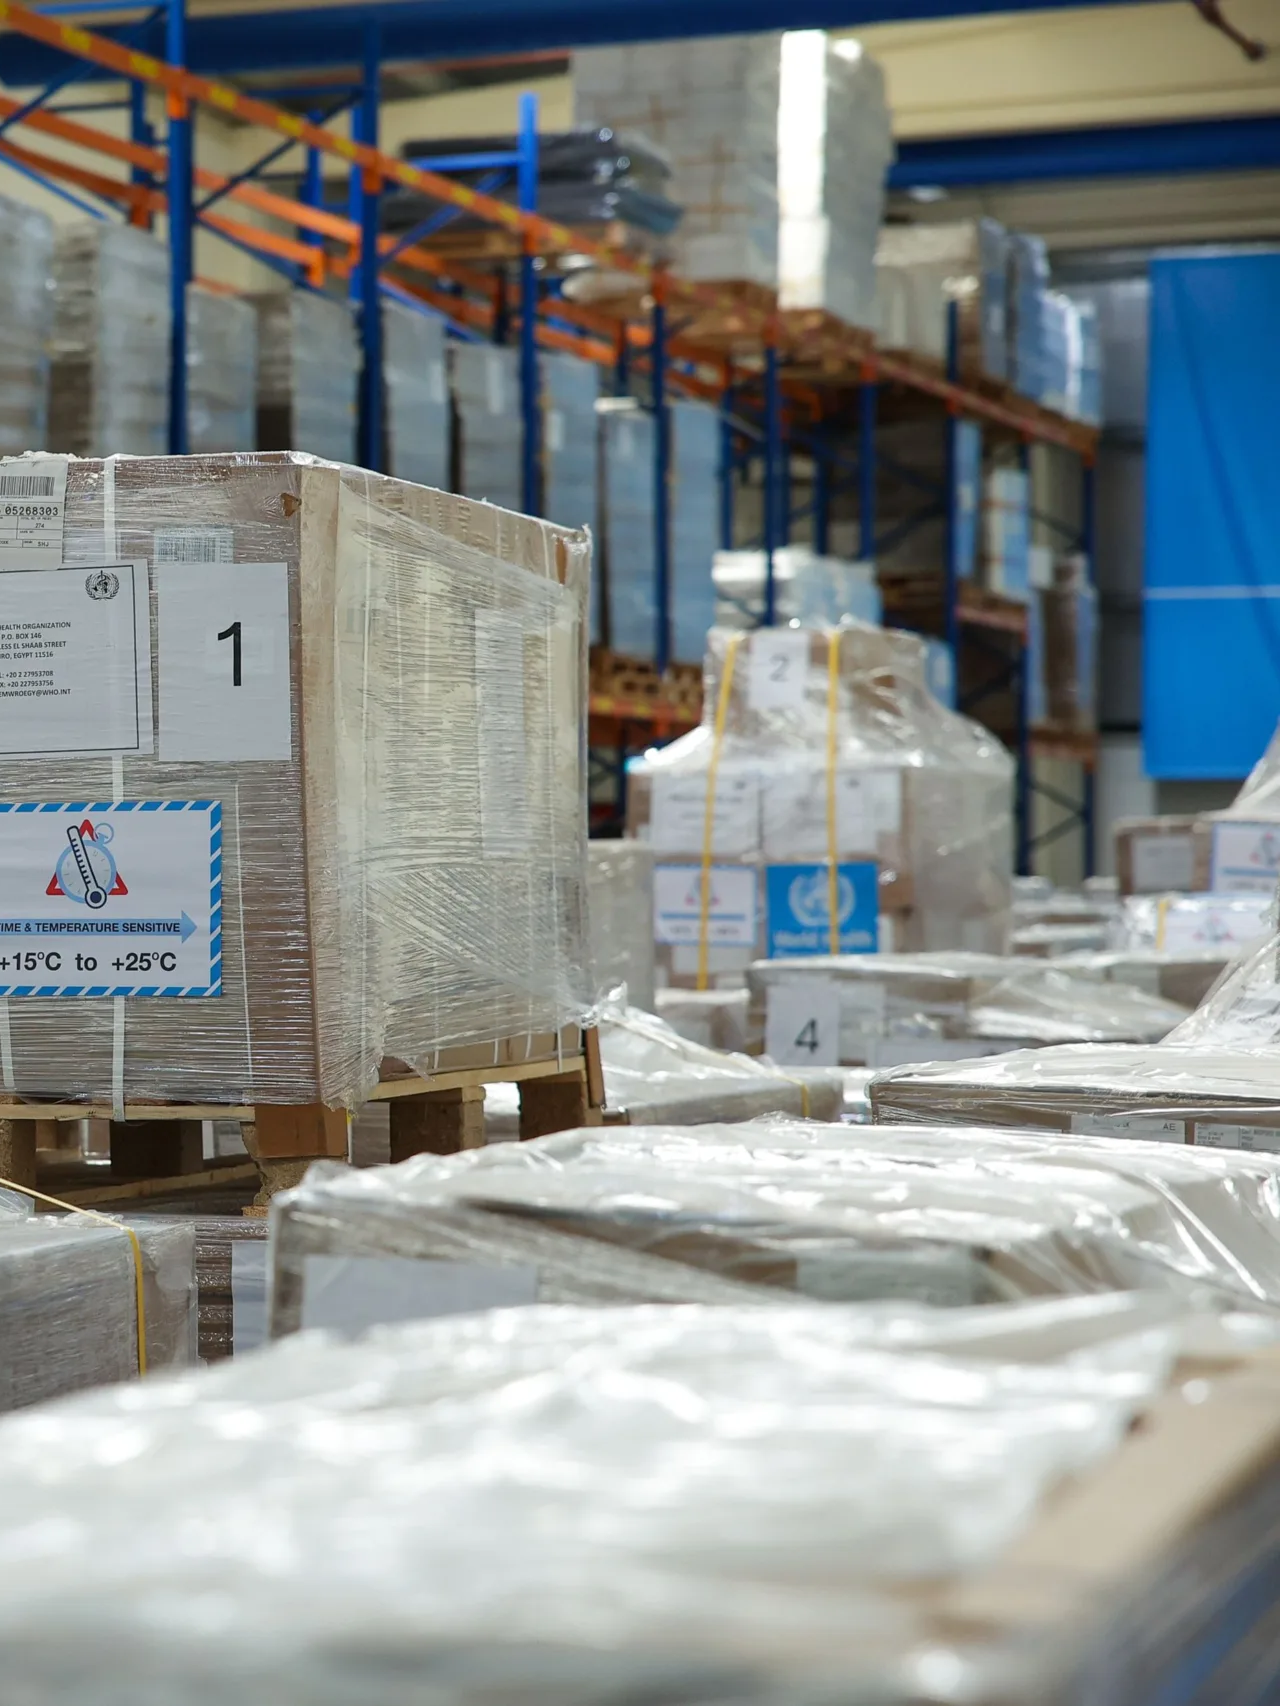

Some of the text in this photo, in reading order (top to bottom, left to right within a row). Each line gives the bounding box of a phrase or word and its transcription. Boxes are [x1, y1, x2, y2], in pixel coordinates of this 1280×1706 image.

[5, 506, 58, 516] 05268303
[22, 622, 71, 630] ORGANIZATION
[218, 622, 242, 686] 1
[768, 652, 790, 682] 2
[24, 923, 32, 932] &
[35, 922, 119, 932] TEMPERATURE
[122, 922, 180, 932] SENSITIVE
[75, 953, 98, 971] to
[794, 1018, 819, 1054] 4
